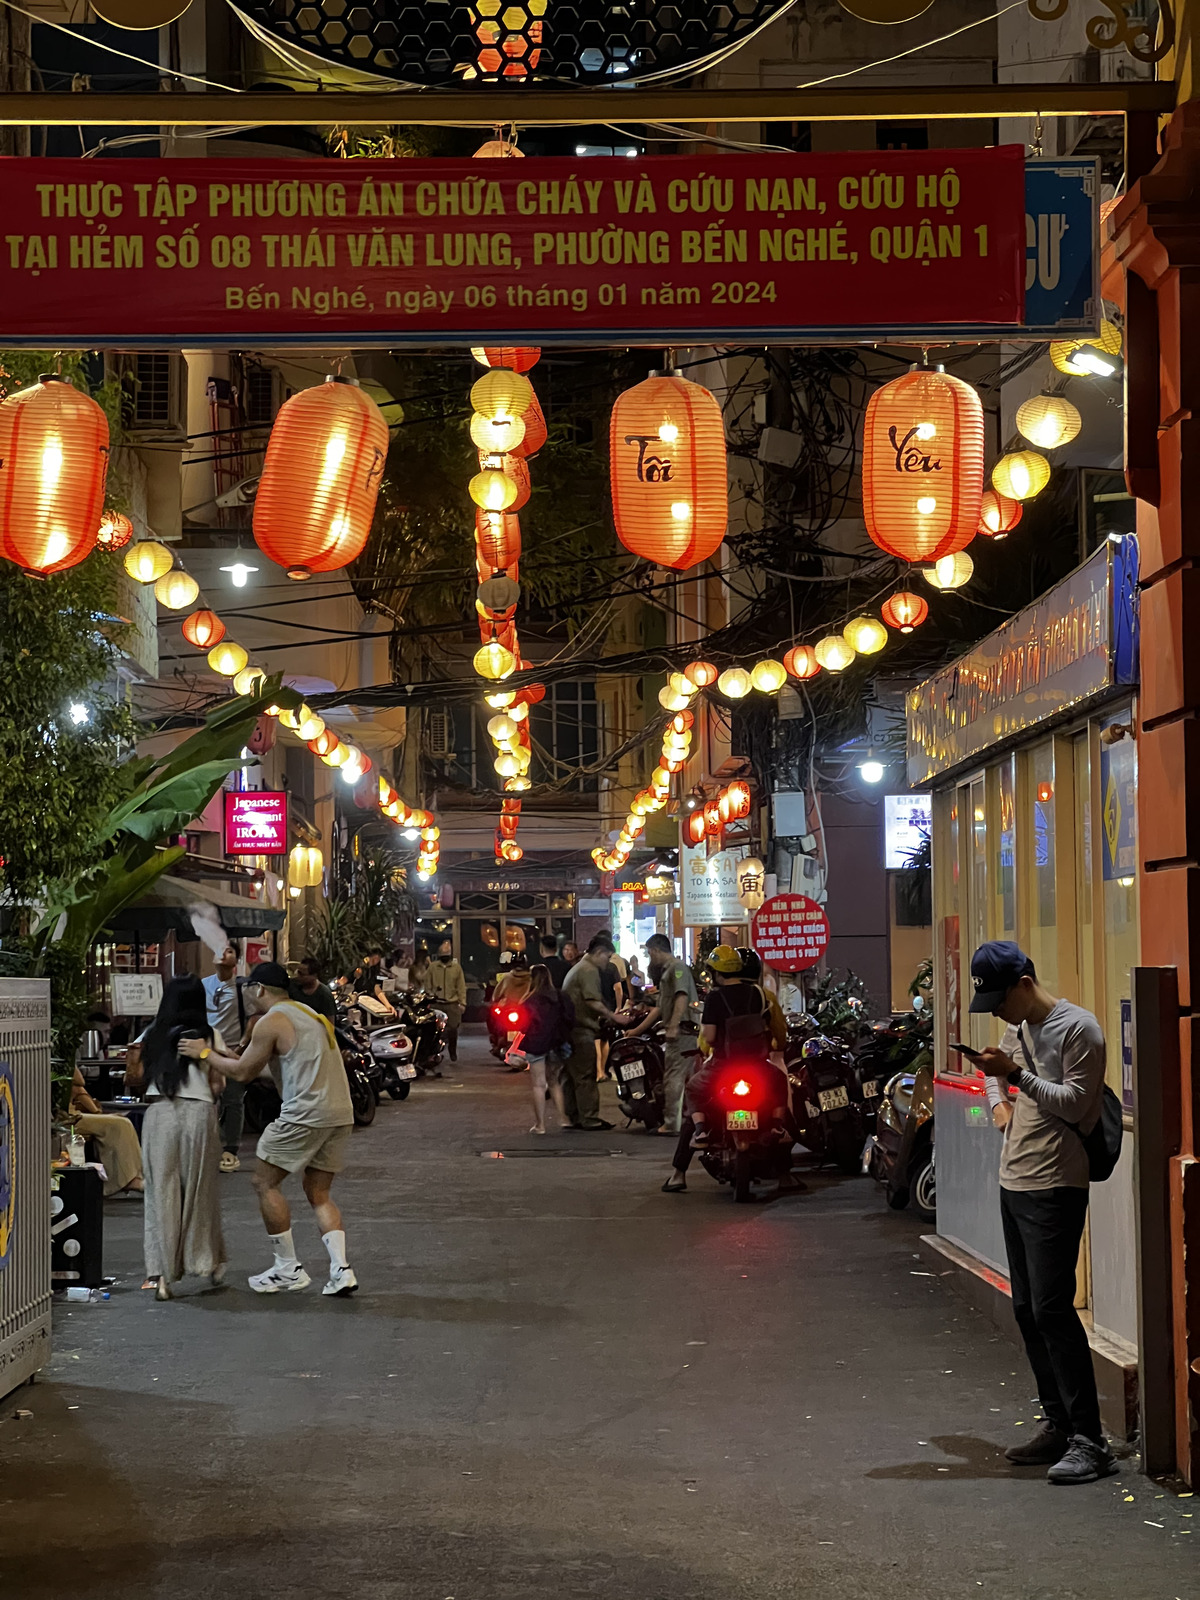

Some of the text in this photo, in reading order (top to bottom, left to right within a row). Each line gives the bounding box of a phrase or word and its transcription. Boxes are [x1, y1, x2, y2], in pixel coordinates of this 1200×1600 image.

[35, 167, 961, 225] THỰC TẬP PHƯƠNG ÁN CHỮA CHÁY VÀ CỨU NẠN, CỨU HỘ
[5, 218, 988, 276] TẠI HẺM SỐ 08 THÁI VĂN LUNG, PHƯỜNG BẾN NGHÉ, QUẬN 1
[225, 280, 778, 315] Bến Nghé, ngày 06 tháng 01 năm 2024
[624, 435, 675, 482] Tôi
[888, 425, 943, 472] Yêu
[233, 797, 280, 811] Japanese
